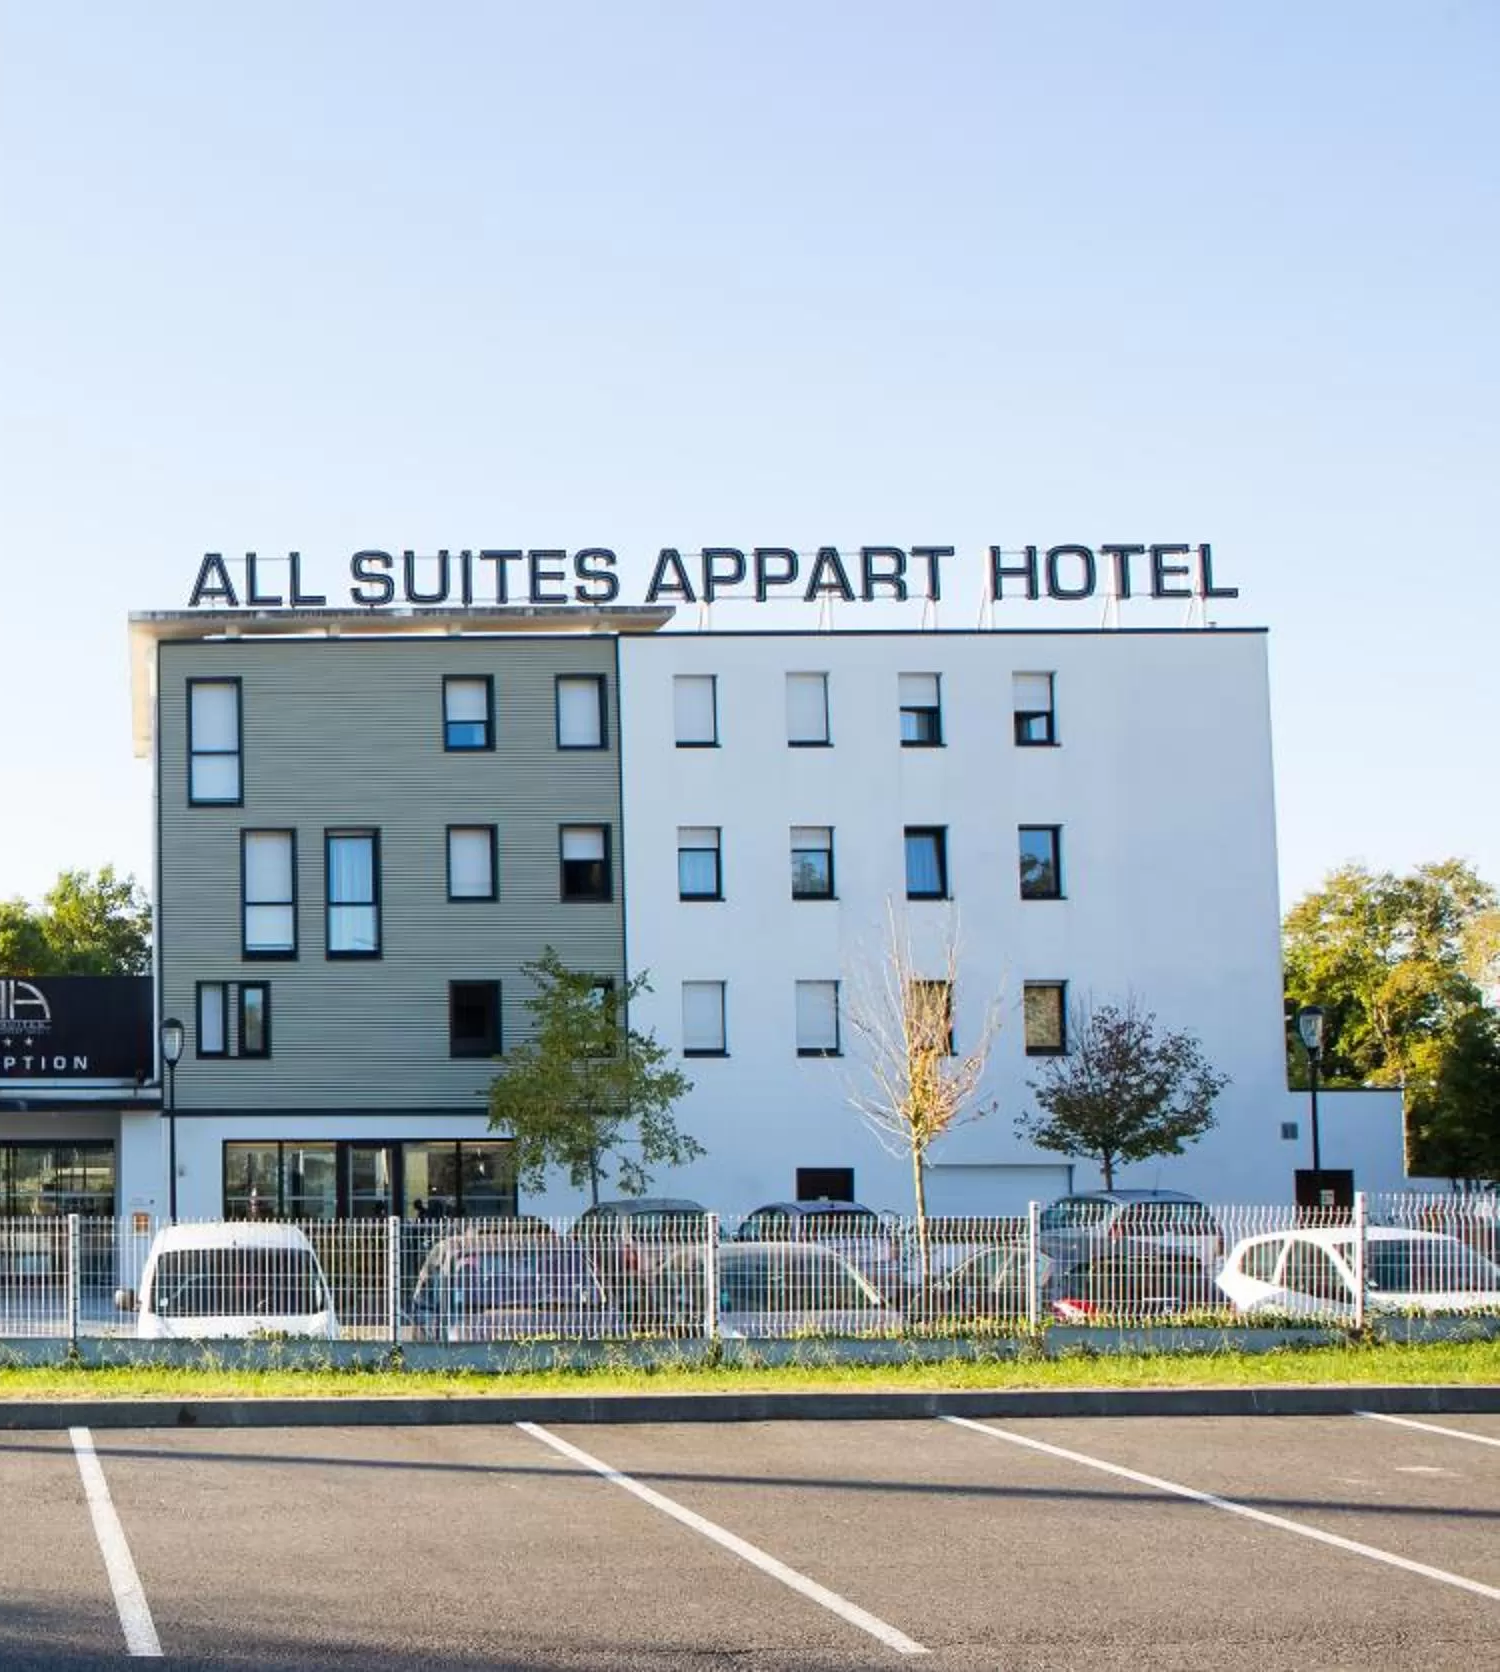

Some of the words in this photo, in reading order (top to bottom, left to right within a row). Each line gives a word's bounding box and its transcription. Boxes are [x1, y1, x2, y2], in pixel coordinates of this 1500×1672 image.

[188, 551, 326, 606] ALL
[350, 547, 619, 605] SUITES
[645, 546, 955, 603] APPART
[990, 543, 1239, 600] HOTEL
